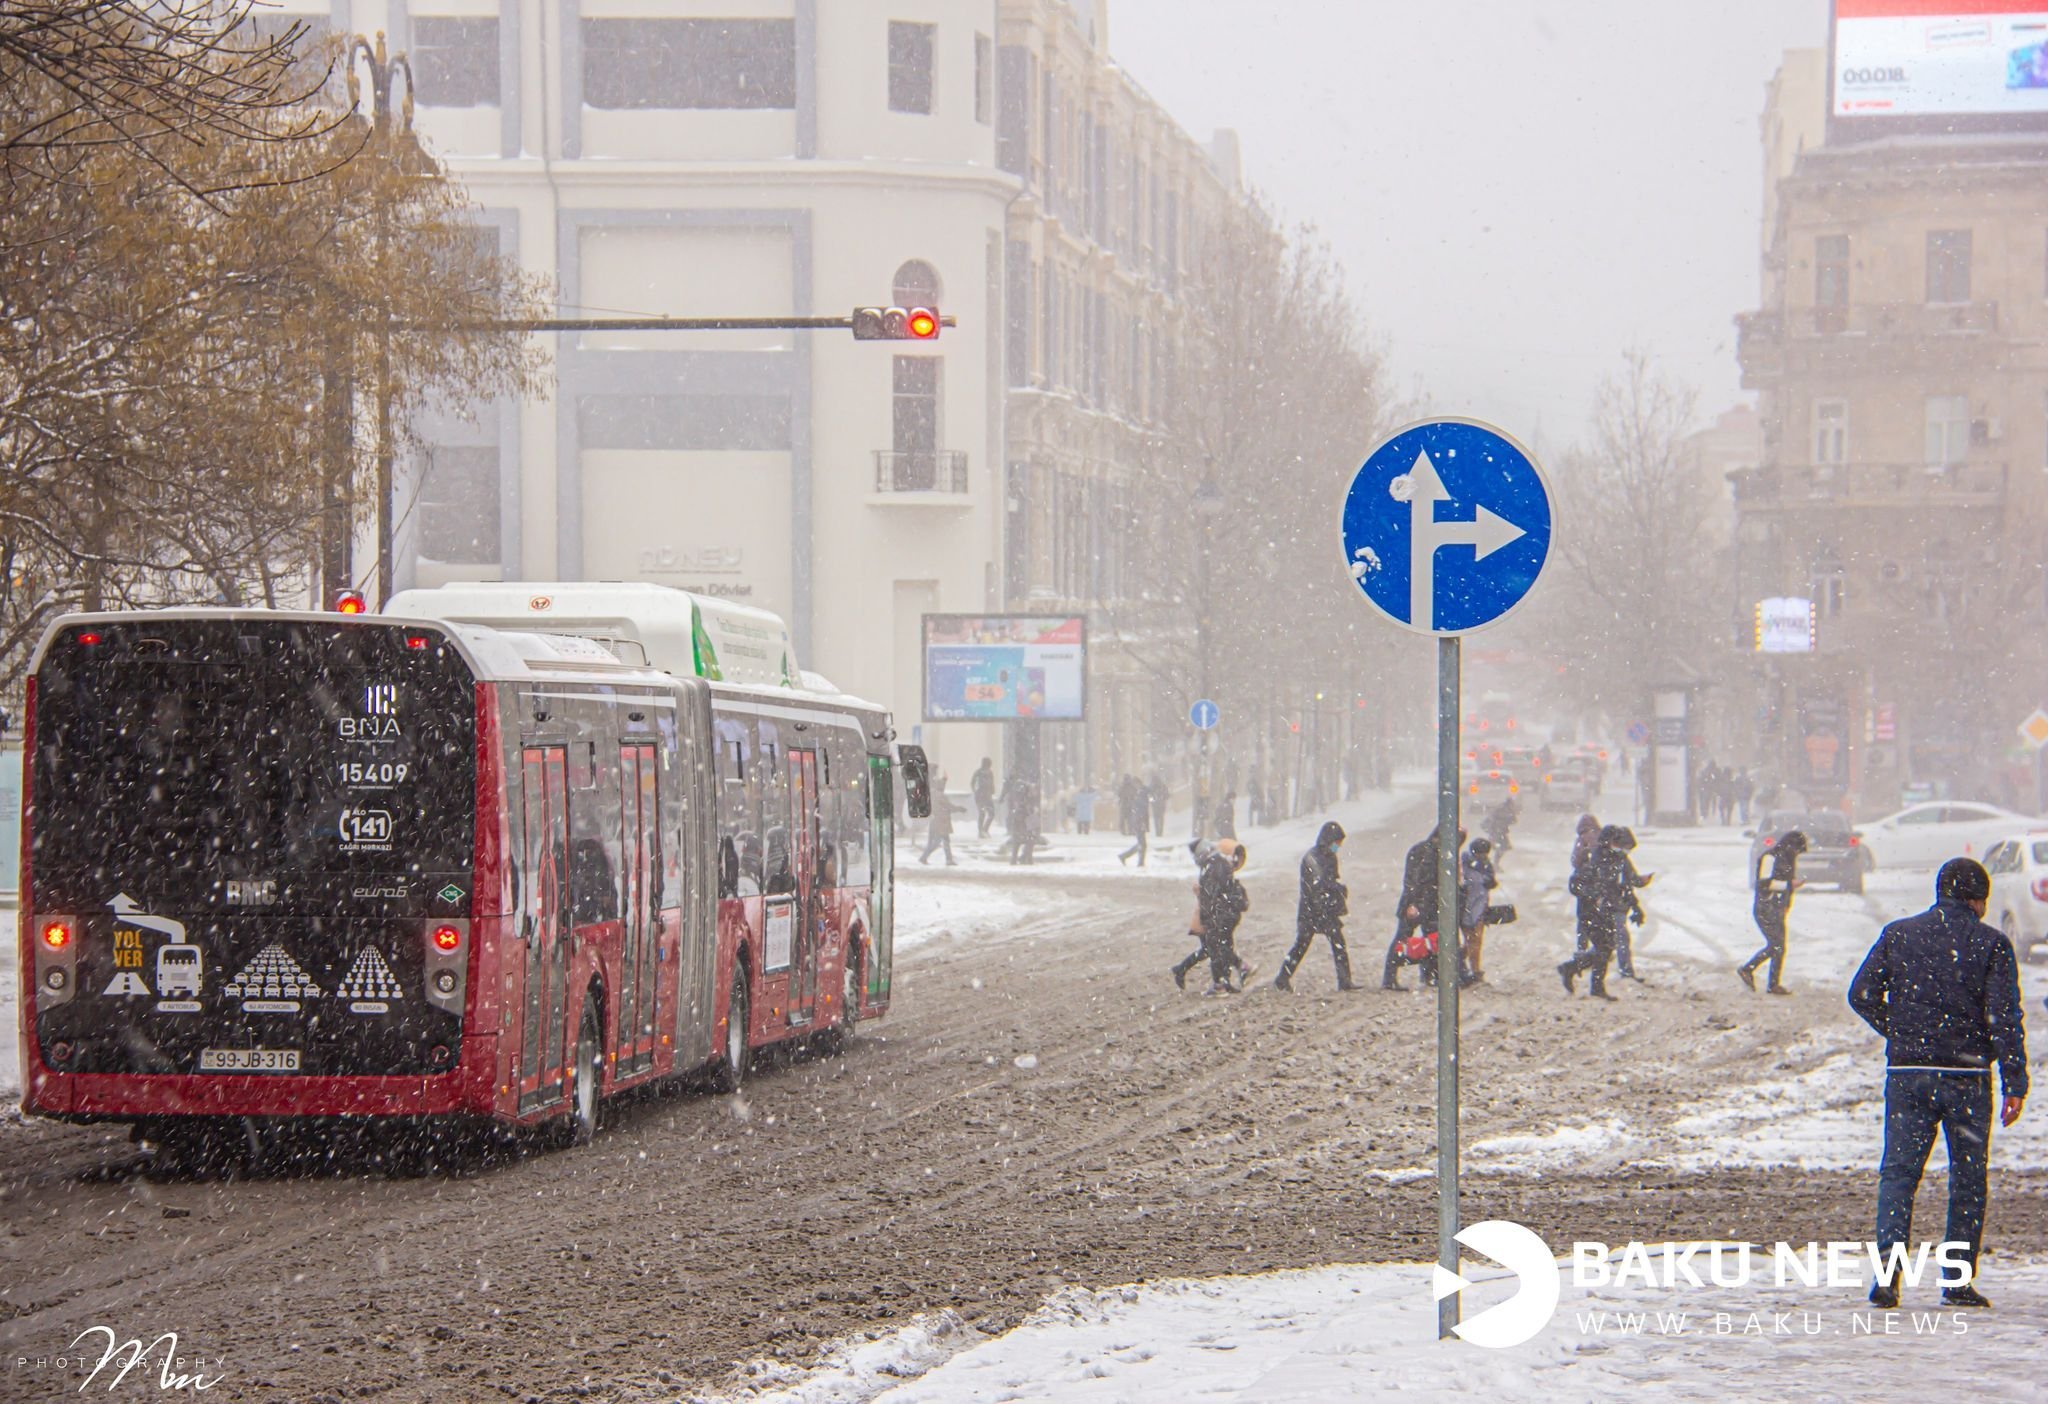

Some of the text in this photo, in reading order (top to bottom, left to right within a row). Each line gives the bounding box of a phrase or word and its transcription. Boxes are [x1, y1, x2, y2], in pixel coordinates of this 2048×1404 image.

[340, 717, 401, 736] BNA
[340, 763, 408, 782] 15409
[350, 816, 386, 837] 141
[226, 880, 277, 905] BMC
[353, 885, 409, 898] euro6
[113, 931, 144, 948] YOL
[113, 949, 143, 968] VER
[216, 1053, 296, 1068] 99-JB-316
